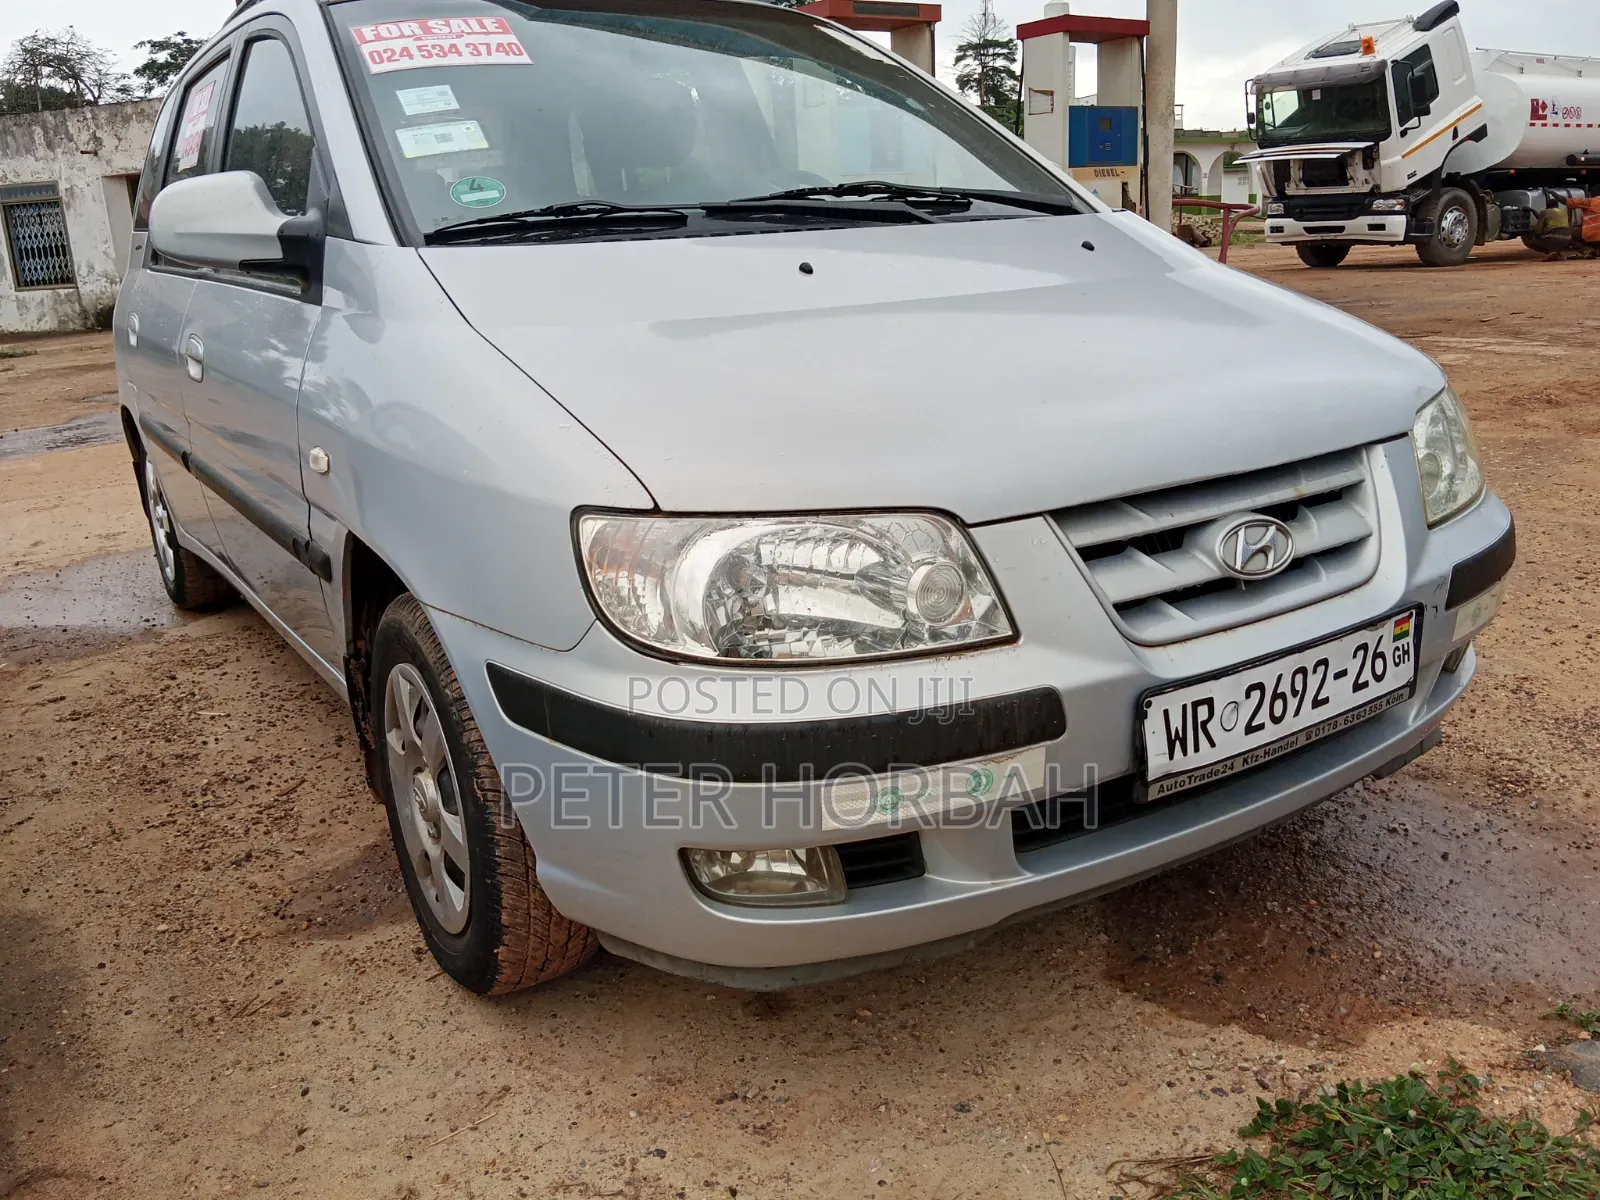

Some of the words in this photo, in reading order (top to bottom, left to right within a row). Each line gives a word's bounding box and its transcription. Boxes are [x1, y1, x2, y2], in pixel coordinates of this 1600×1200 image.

[360, 20, 422, 41] FOR
[427, 17, 504, 35] SALE
[368, 46, 414, 65] 024
[416, 43, 463, 60] 534
[464, 42, 524, 57] 3740
[1093, 168, 1120, 178] DIESEL
[468, 178, 485, 192] 4
[1163, 696, 1217, 761] WR
[1244, 634, 1388, 737] 2692-26
[1392, 641, 1411, 668] GH
[1156, 760, 1235, 796] AutoTrade24
[1241, 737, 1299, 767] Kfz-Handel
[1385, 692, 1405, 708] Köln
